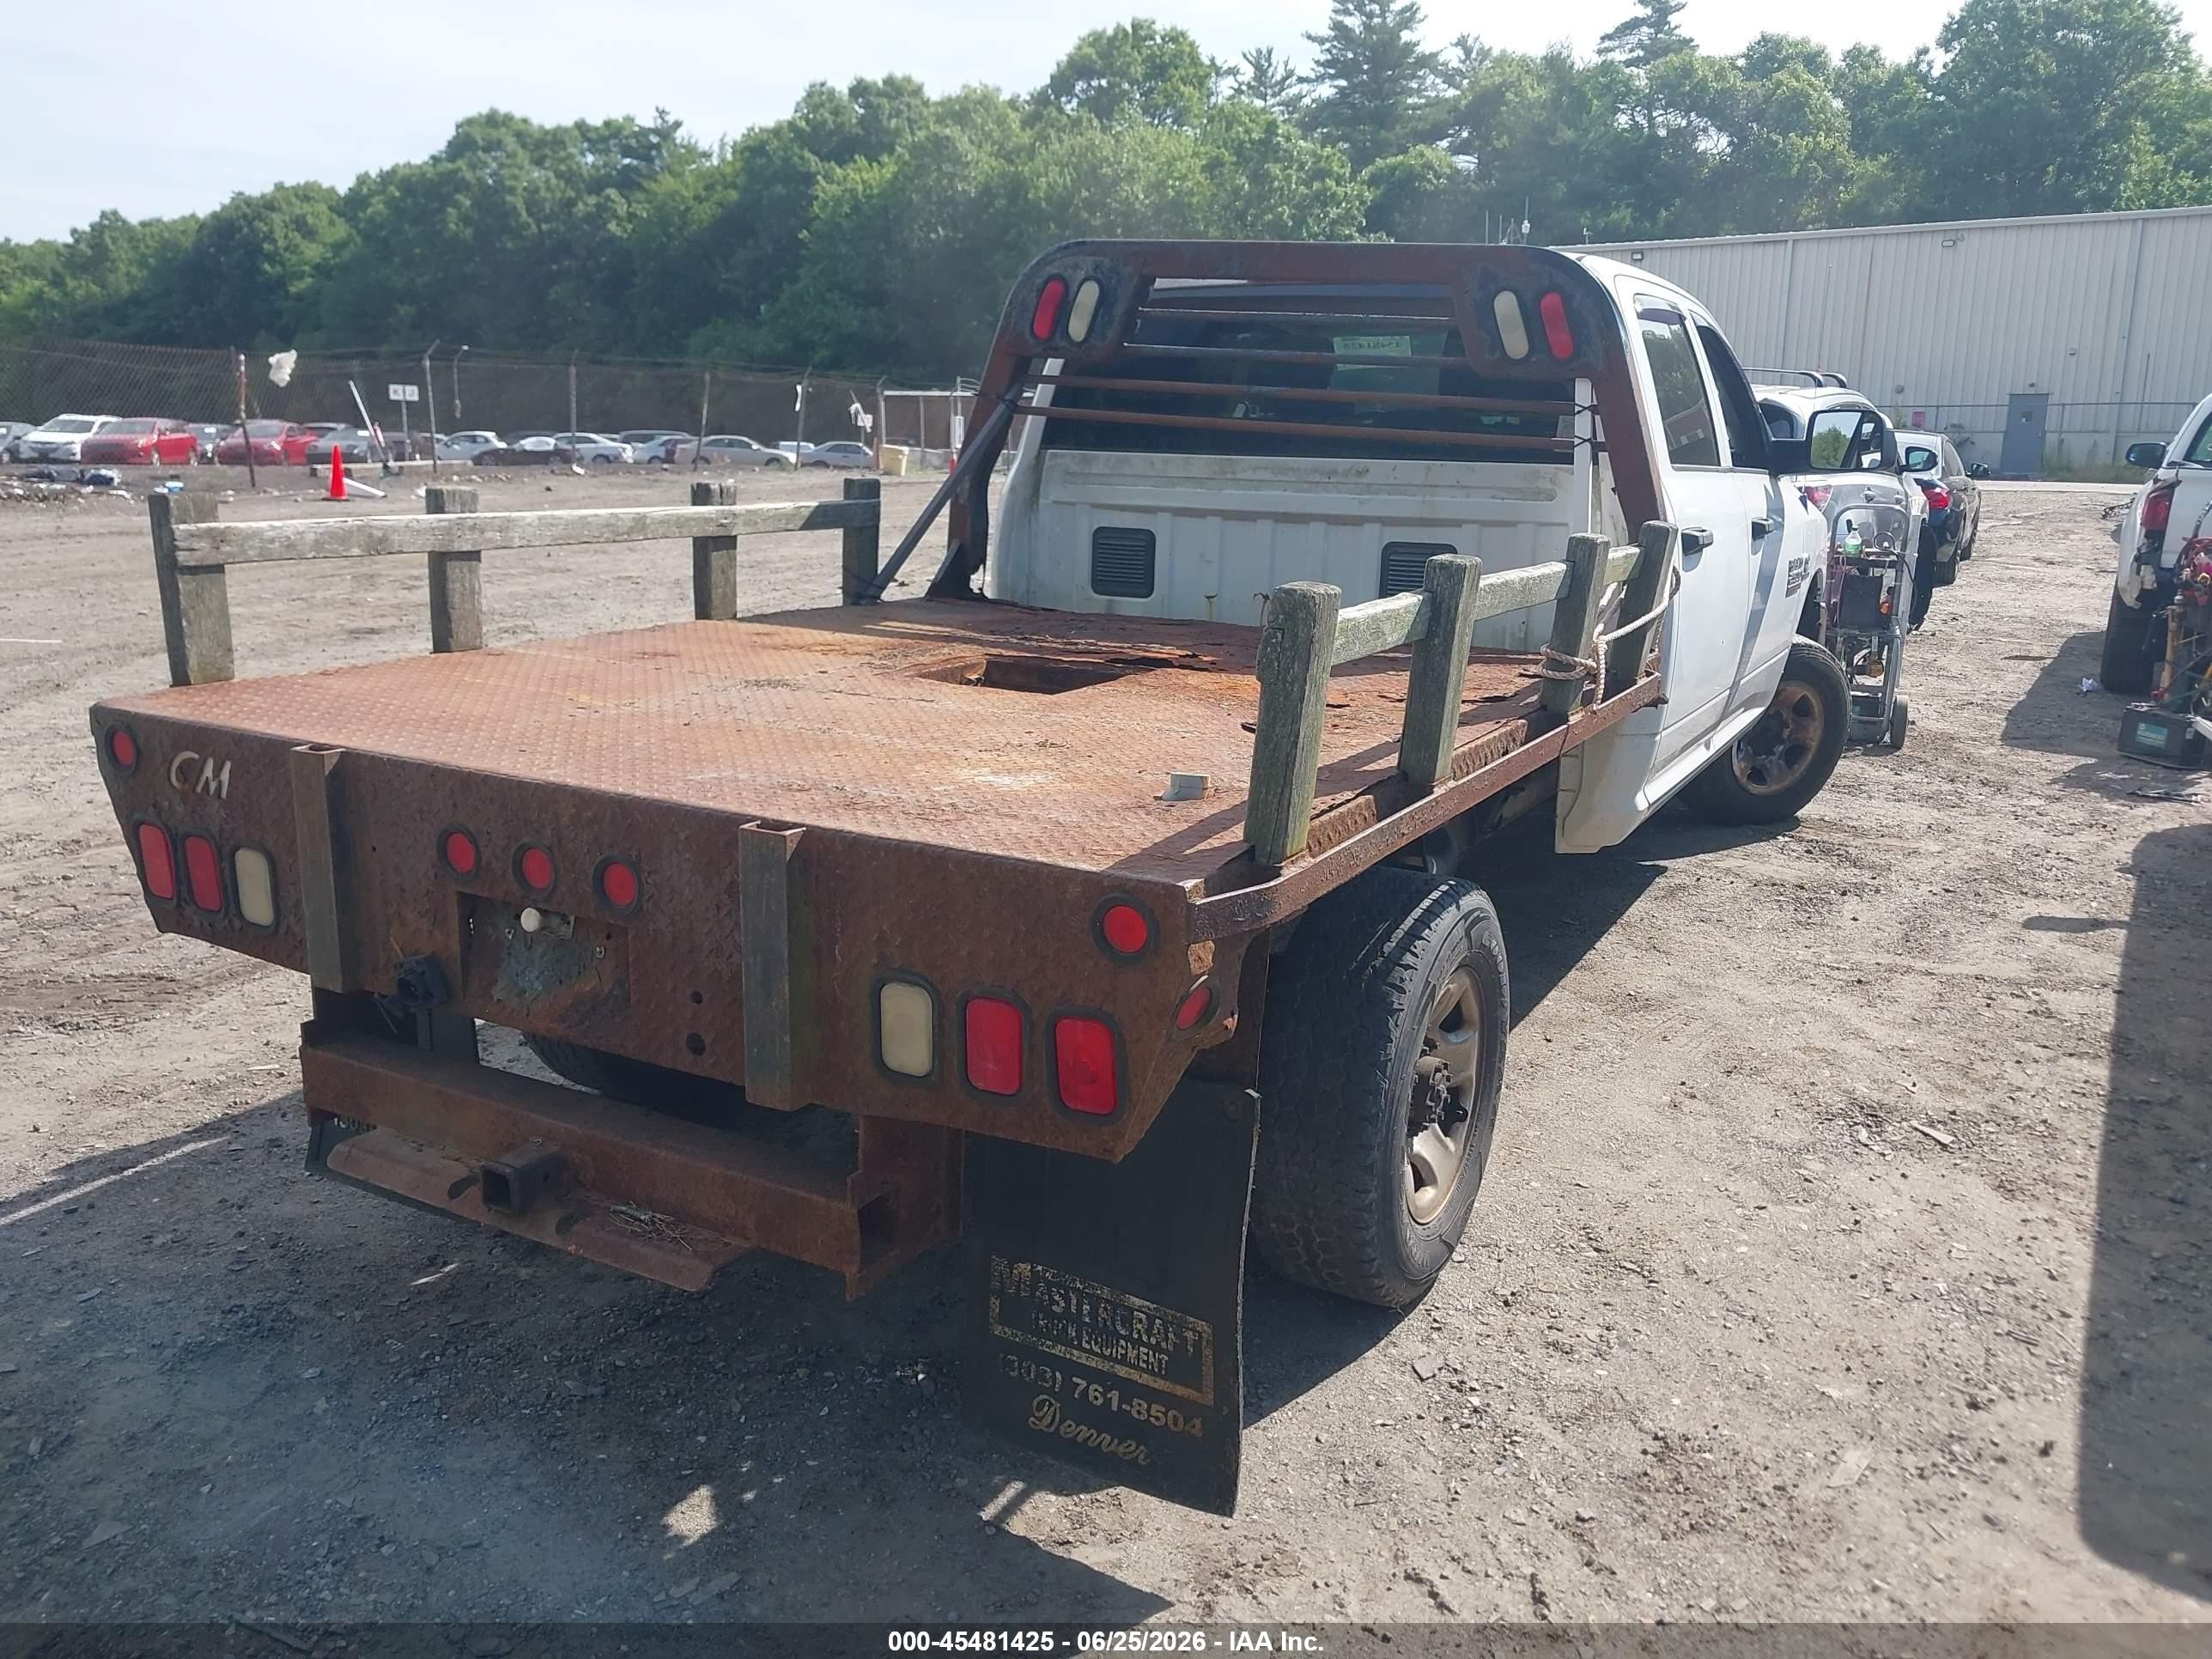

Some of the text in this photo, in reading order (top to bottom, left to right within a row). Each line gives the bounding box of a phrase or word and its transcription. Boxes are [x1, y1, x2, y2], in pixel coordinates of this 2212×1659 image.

[170, 750, 231, 799] CM
[1082, 1328, 1169, 1375] EQUIPMENT
[1028, 1394, 1152, 1465] Denver
[1072, 1376, 1203, 1438] 761-8504
